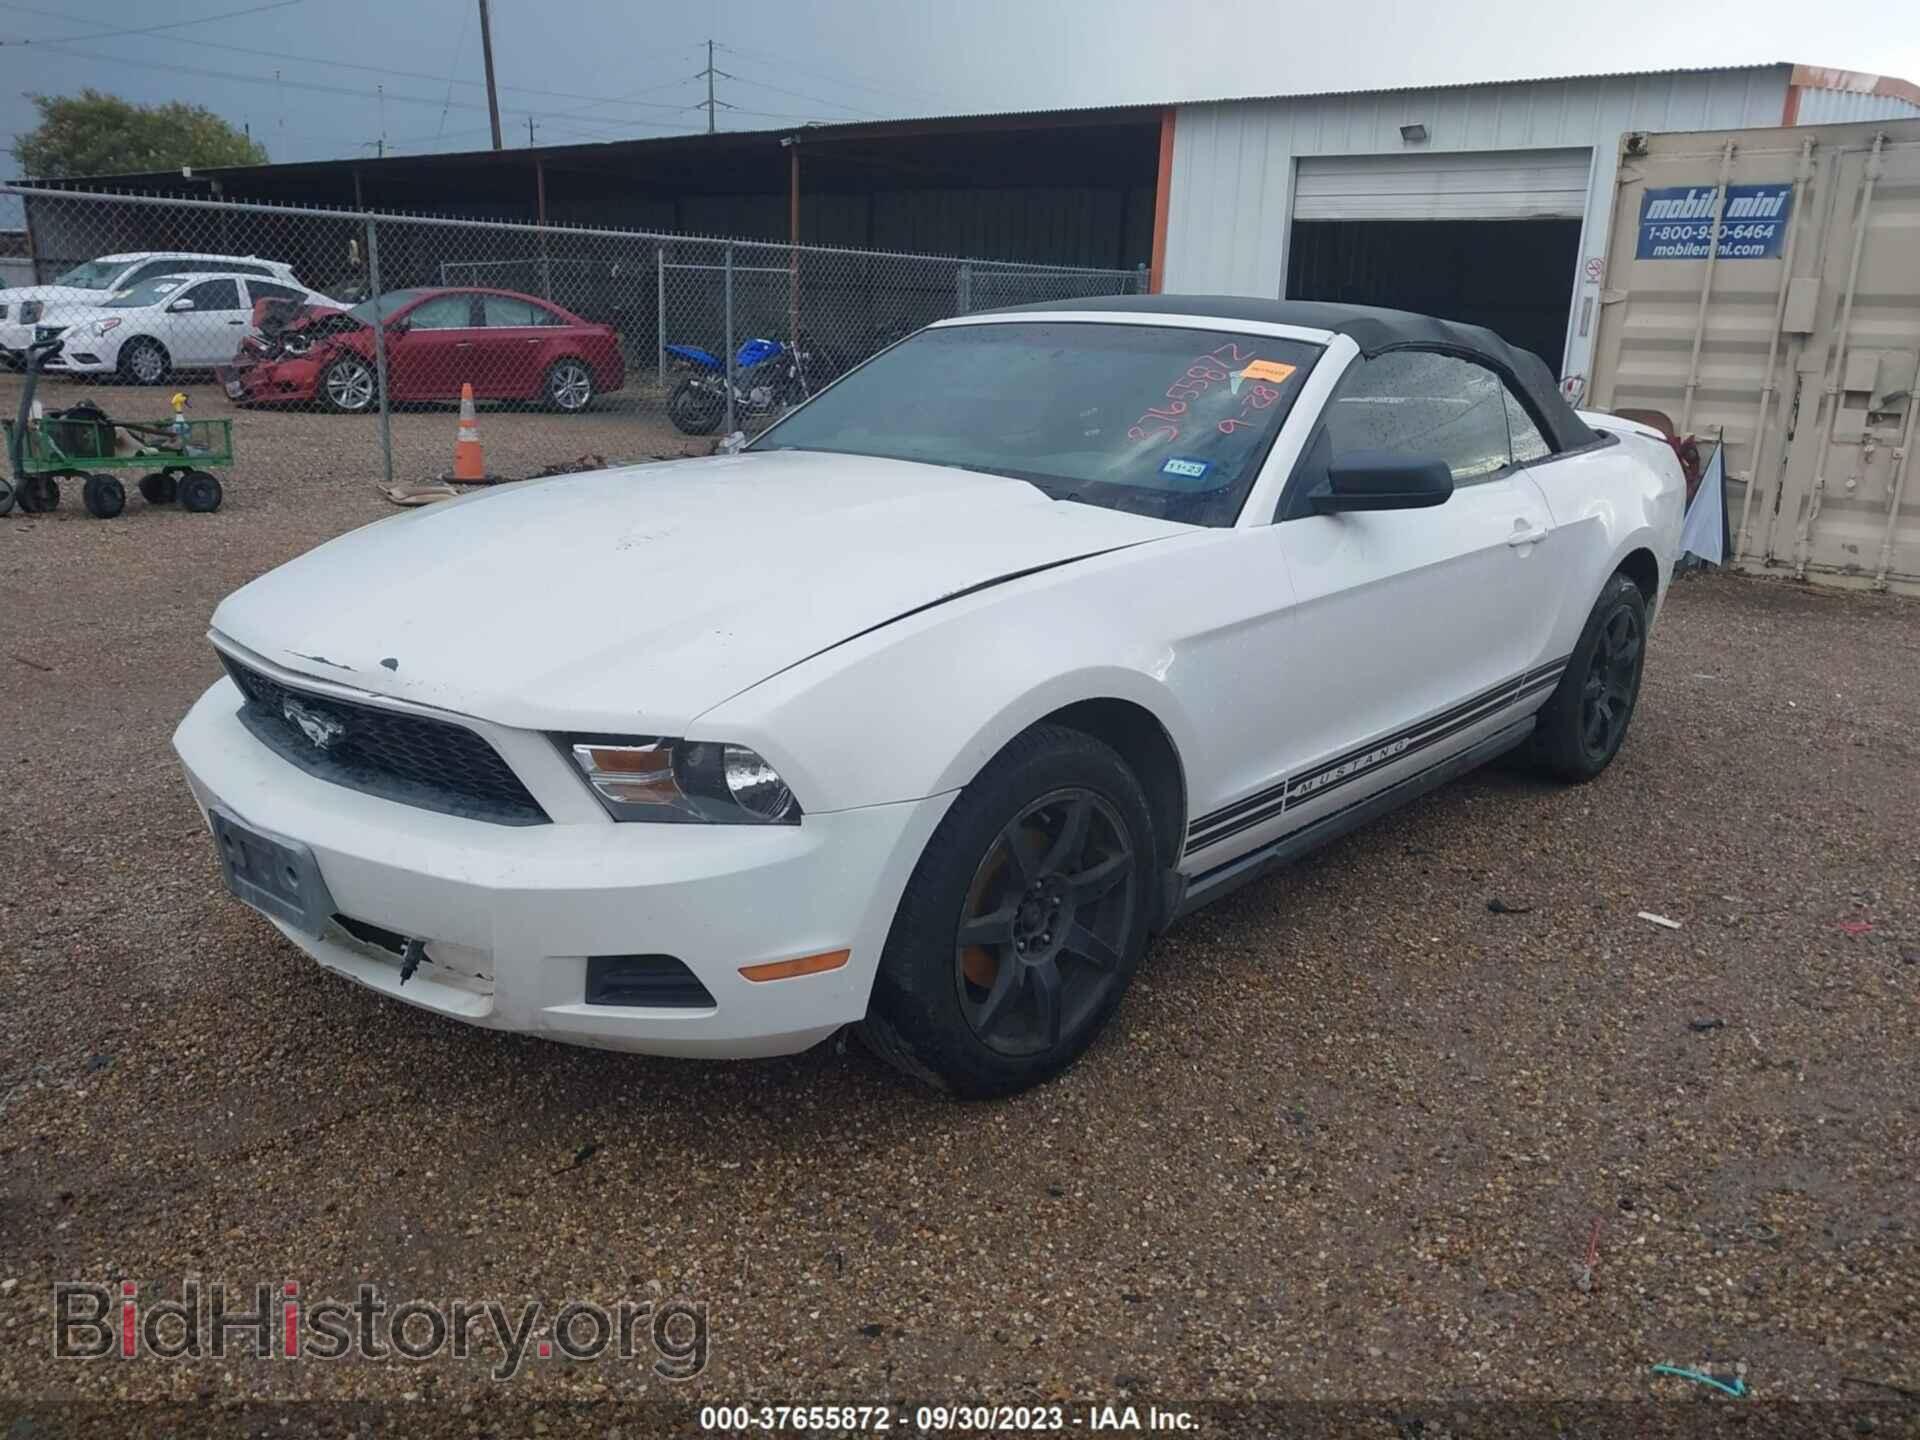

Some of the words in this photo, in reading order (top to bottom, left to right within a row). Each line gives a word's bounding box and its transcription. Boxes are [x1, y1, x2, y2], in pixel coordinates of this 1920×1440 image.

[1727, 191, 1788, 217] mini
[1652, 242, 1765, 256] mobilemni.com
[1300, 740, 1405, 793] MUSTANG
